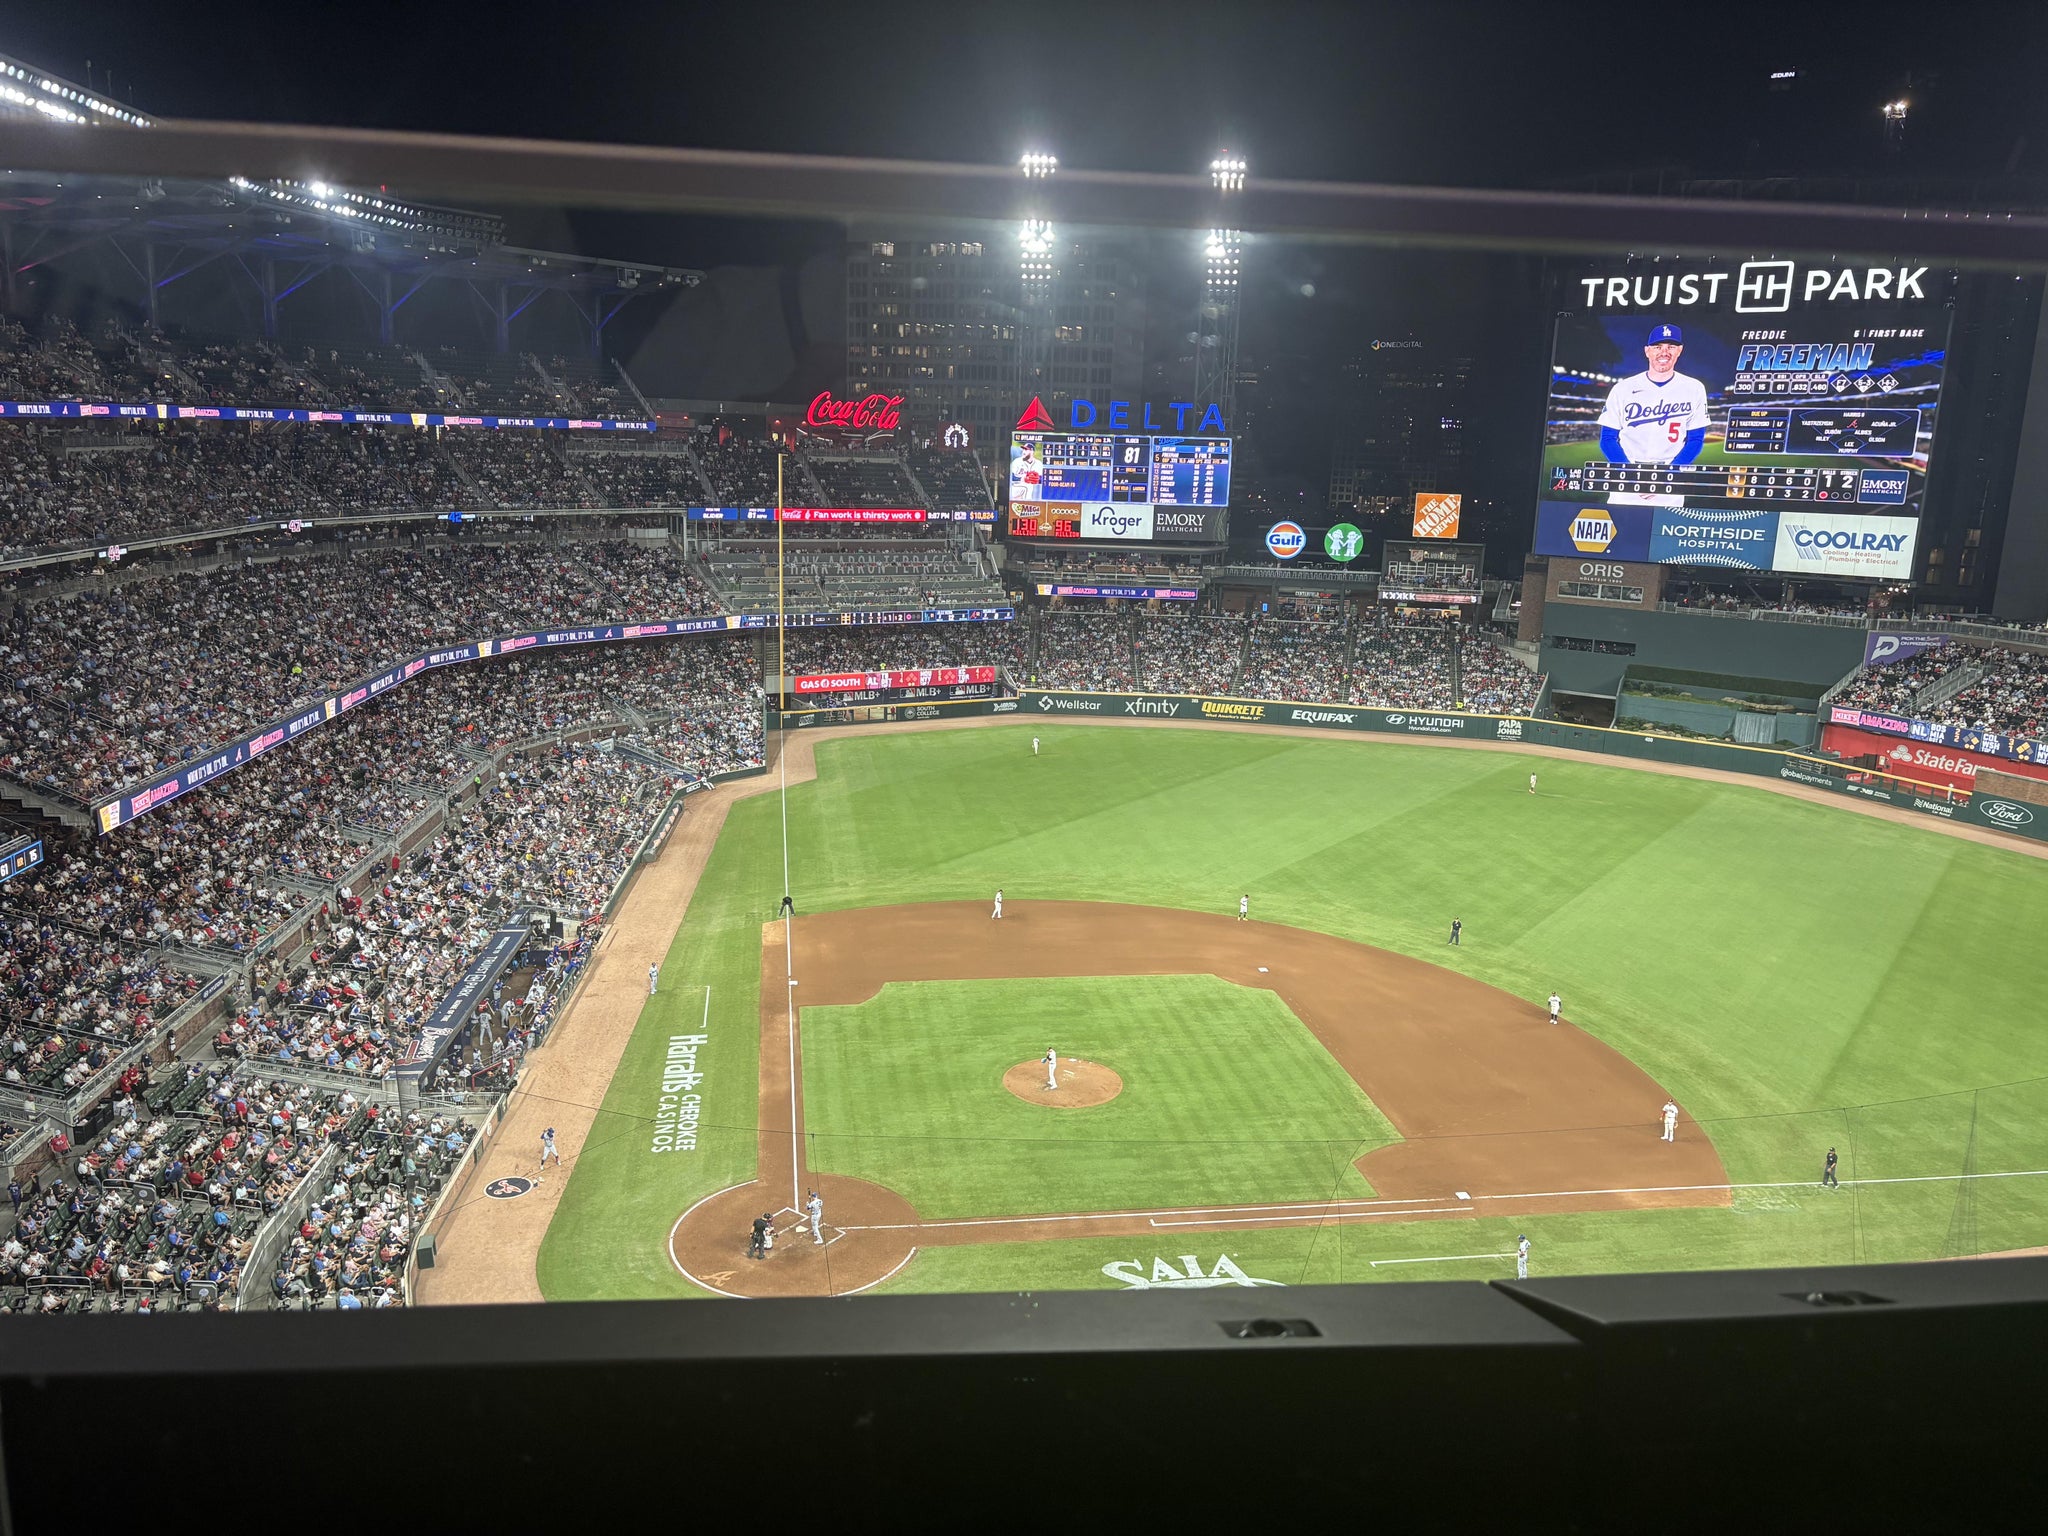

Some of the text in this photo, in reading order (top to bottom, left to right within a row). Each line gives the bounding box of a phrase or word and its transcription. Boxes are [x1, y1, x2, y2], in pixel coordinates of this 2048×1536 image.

[1582, 267, 1929, 306] TRUIST PARK
[1742, 330, 1925, 340] FREDDIE FIRST BASE
[1736, 342, 1875, 371] FREEMAN
[807, 390, 904, 430] Coca-Cola
[1071, 400, 1226, 432] DELTA
[1624, 400, 1692, 426] Dodgers
[1668, 422, 1681, 443] 5
[1124, 446, 1140, 464] 81
[1588, 470, 1854, 488] 0 2 0 1 0 0 3 8 0 6 0 1 2
[1862, 480, 1906, 490] EMORY
[1588, 482, 1810, 499] 3 0 0 0 0 0 3 6 0 3 2
[814, 511, 829, 520] Fan
[830, 511, 852, 520] work
[854, 511, 861, 520] is
[862, 511, 890, 521] thirsty
[892, 511, 912, 520] work
[1414, 494, 1460, 536] HOME
[1420, 498, 1440, 516] THE
[1016, 518, 1072, 532] 130 96
[1092, 506, 1142, 536] Kroger
[1156, 514, 1206, 527] EMORY
[1430, 510, 1460, 537] DEPOT
[1269, 533, 1304, 546] Gulf
[1576, 520, 1766, 541] NAPA NORTHSIDE
[1678, 540, 1744, 551] HOSPITAL
[1795, 529, 1909, 552] COOLRAY
[1580, 562, 1624, 578] ORIS
[1828, 556, 1898, 566] Plumbing Electrical
[801, 680, 820, 690] GAS
[830, 678, 860, 688] SOUTH
[866, 677, 878, 686] AL
[854, 690, 881, 700] MLB+
[916, 688, 942, 697] MLB+
[966, 684, 992, 694] MLB+
[1056, 697, 1265, 716] Wellstar xfinity QUIKRETE
[1292, 710, 1522, 728] EQUIFAX HYUNDAI PAPA
[1835, 712, 1859, 722] MIKE'S
[1860, 713, 1908, 733] AMAZING
[1912, 724, 1928, 736] NL
[1930, 723, 1946, 732] BOS
[1982, 734, 1999, 742] COL
[1496, 727, 1522, 736] JOHNS
[1930, 730, 1945, 740] MIA
[1982, 741, 2000, 750] WSH
[1922, 800, 2023, 822] National Ford
[29, 849, 38, 862] 15
[474, 956, 498, 975] TRUIST
[662, 1034, 708, 1093] Harrah's
[650, 1094, 679, 1153] CASINOS
[674, 1094, 702, 1152] CHEROKEE
